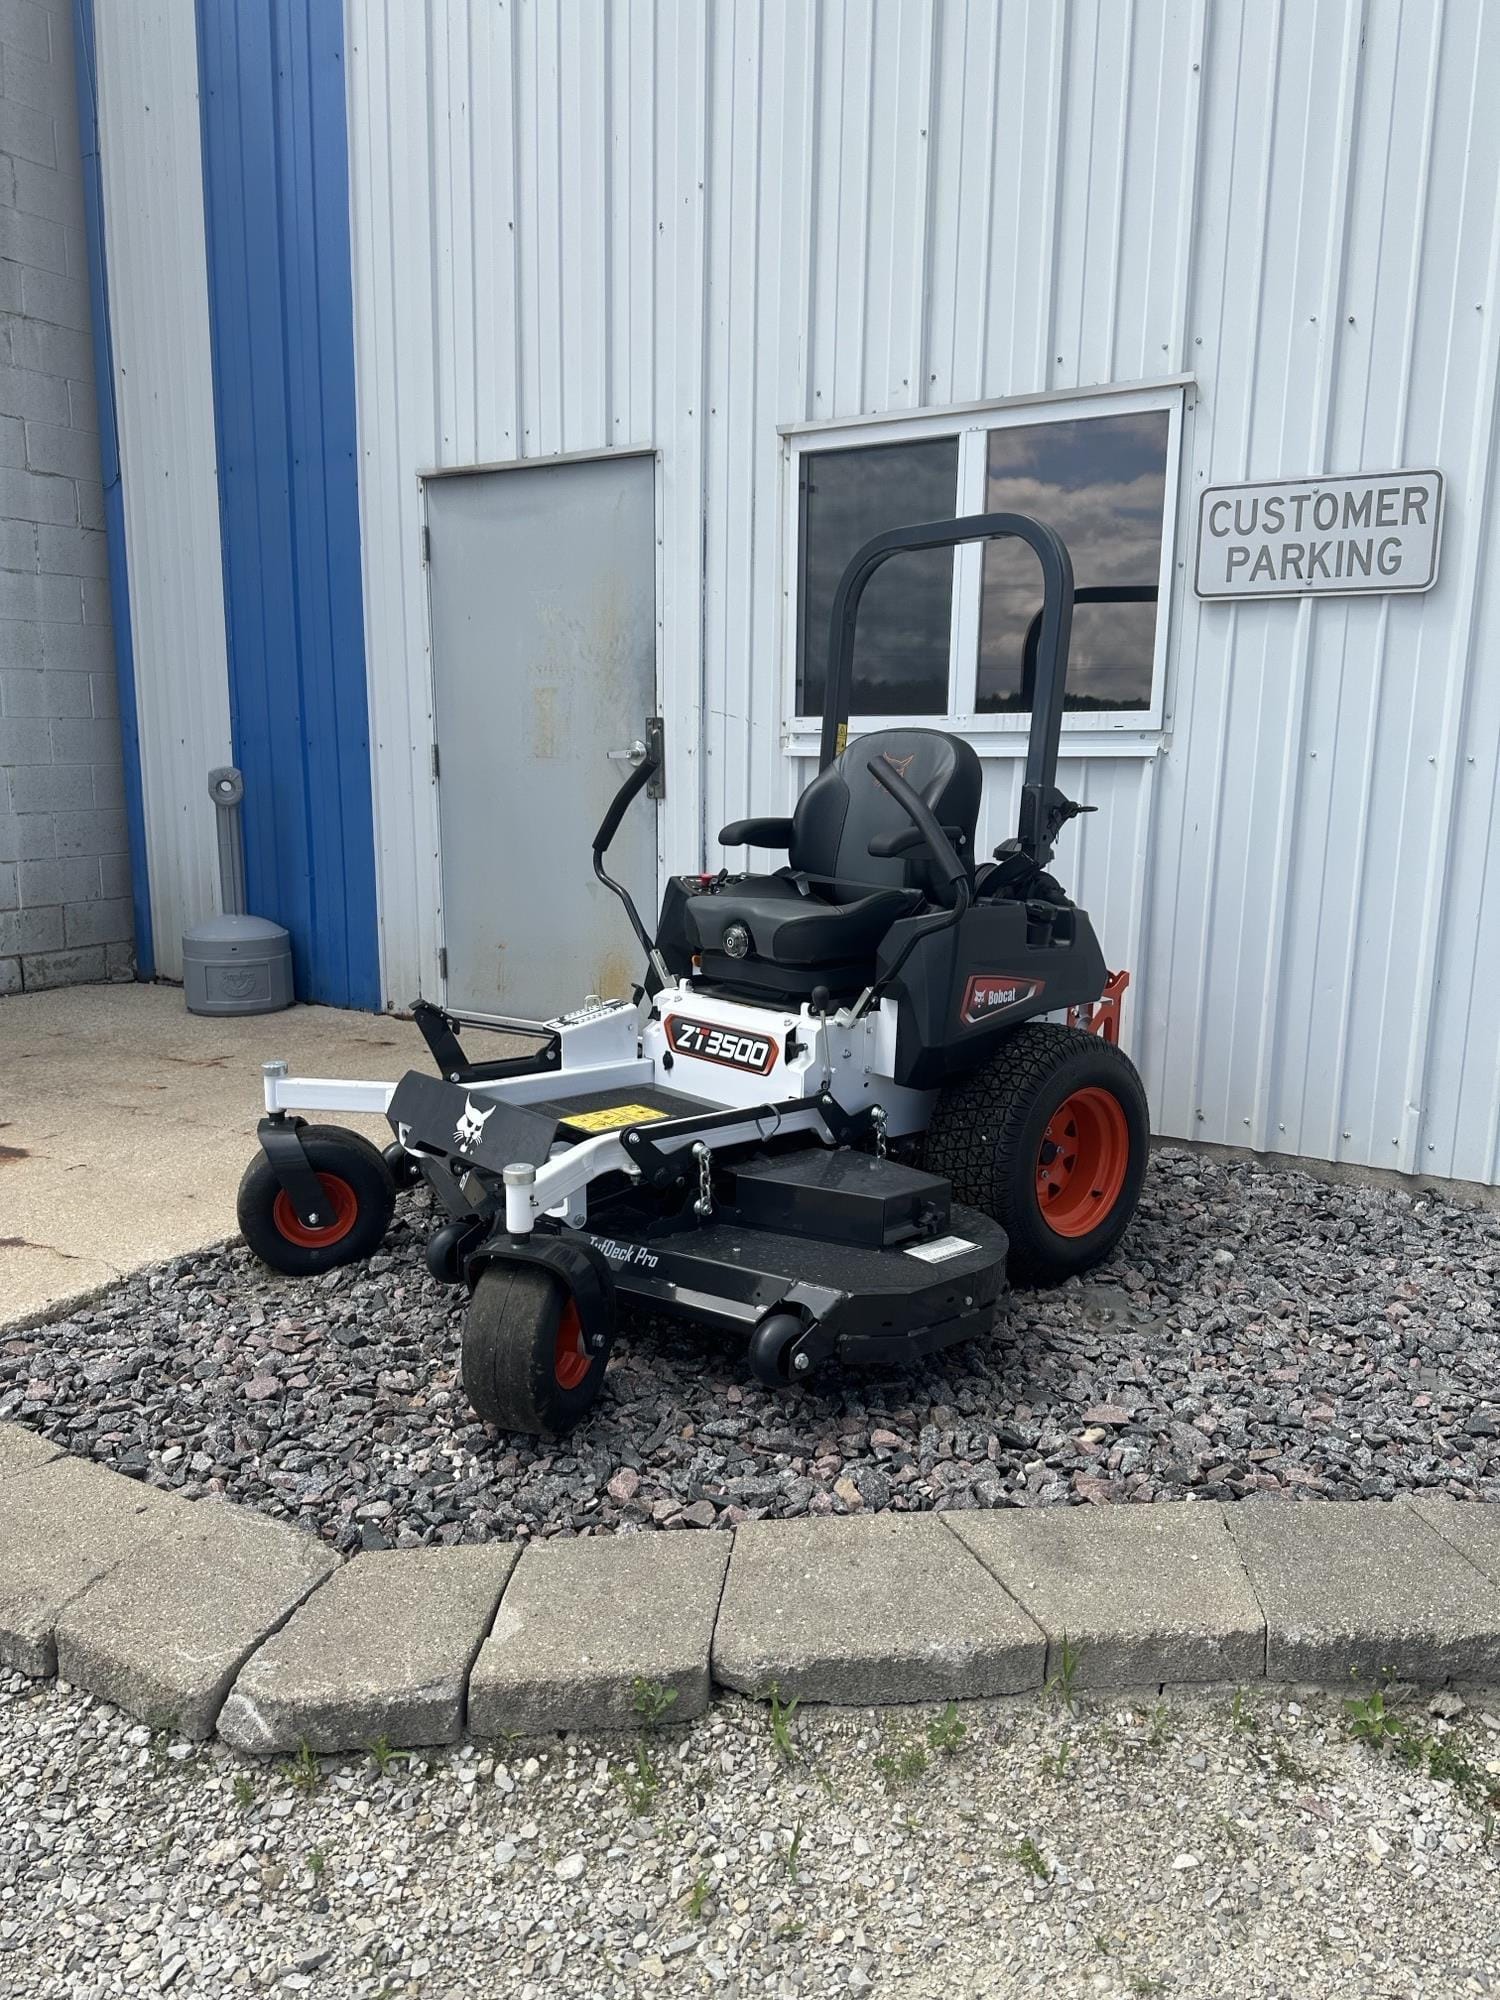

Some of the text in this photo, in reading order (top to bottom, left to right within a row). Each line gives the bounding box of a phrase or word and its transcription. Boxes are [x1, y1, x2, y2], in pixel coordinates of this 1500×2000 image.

[1208, 486, 1429, 537] CUSTOMER
[1225, 536, 1403, 583] PARKING
[988, 987, 1016, 1006] Bobcat
[676, 1023, 769, 1067] ZT3500
[633, 1246, 659, 1268] Pro
